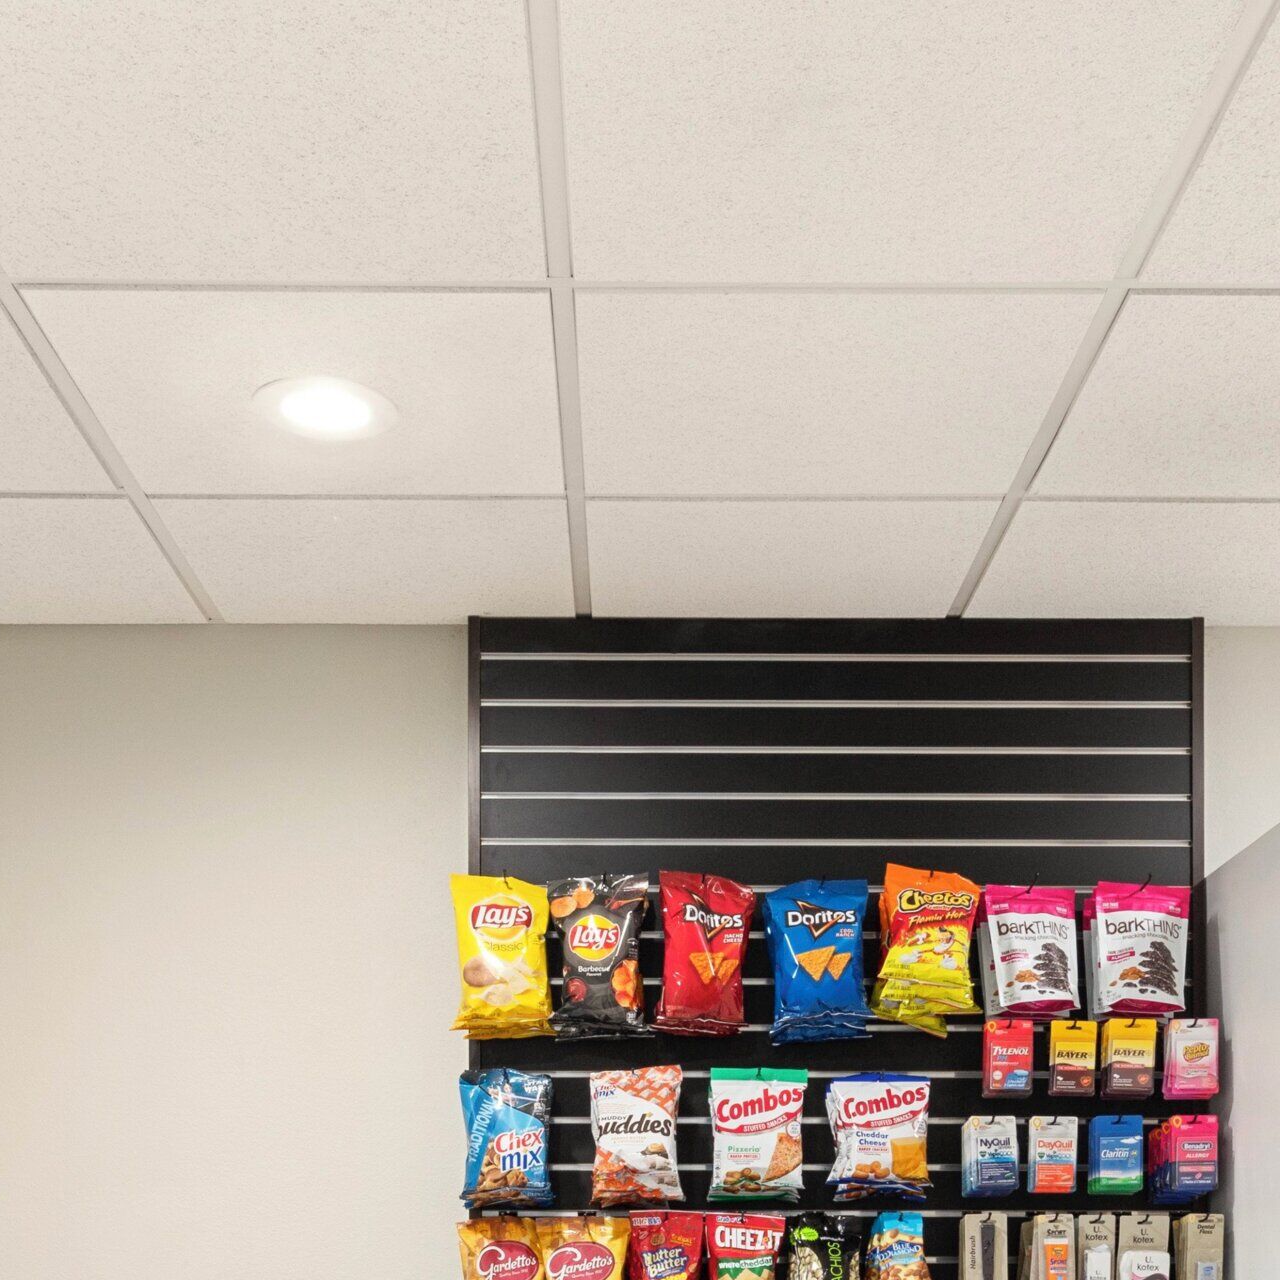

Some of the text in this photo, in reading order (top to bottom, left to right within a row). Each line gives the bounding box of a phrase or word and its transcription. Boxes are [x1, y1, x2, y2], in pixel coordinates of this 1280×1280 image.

[899, 889, 973, 912] Cheetos
[684, 904, 743, 928] Doritos
[787, 910, 856, 927] Doritos
[993, 1046, 1029, 1056] TYLENOL
[1057, 1051, 1088, 1059] BAYER
[1113, 1048, 1146, 1057] BAYER
[716, 1088, 802, 1123] Combos
[844, 1087, 926, 1118] Combos
[743, 1115, 788, 1132] STUFFED SNACKS
[495, 1128, 544, 1153] Chex
[856, 1131, 889, 1139] Cheddar
[979, 1138, 1011, 1147] NyQuil
[728, 1145, 760, 1153] Pizzeria
[1038, 1140, 1073, 1150] DayQuil
[501, 1147, 543, 1172] mix
[1101, 1149, 1129, 1159] Claritin
[643, 1248, 682, 1265] Nutter
[647, 1257, 687, 1278] Butter
